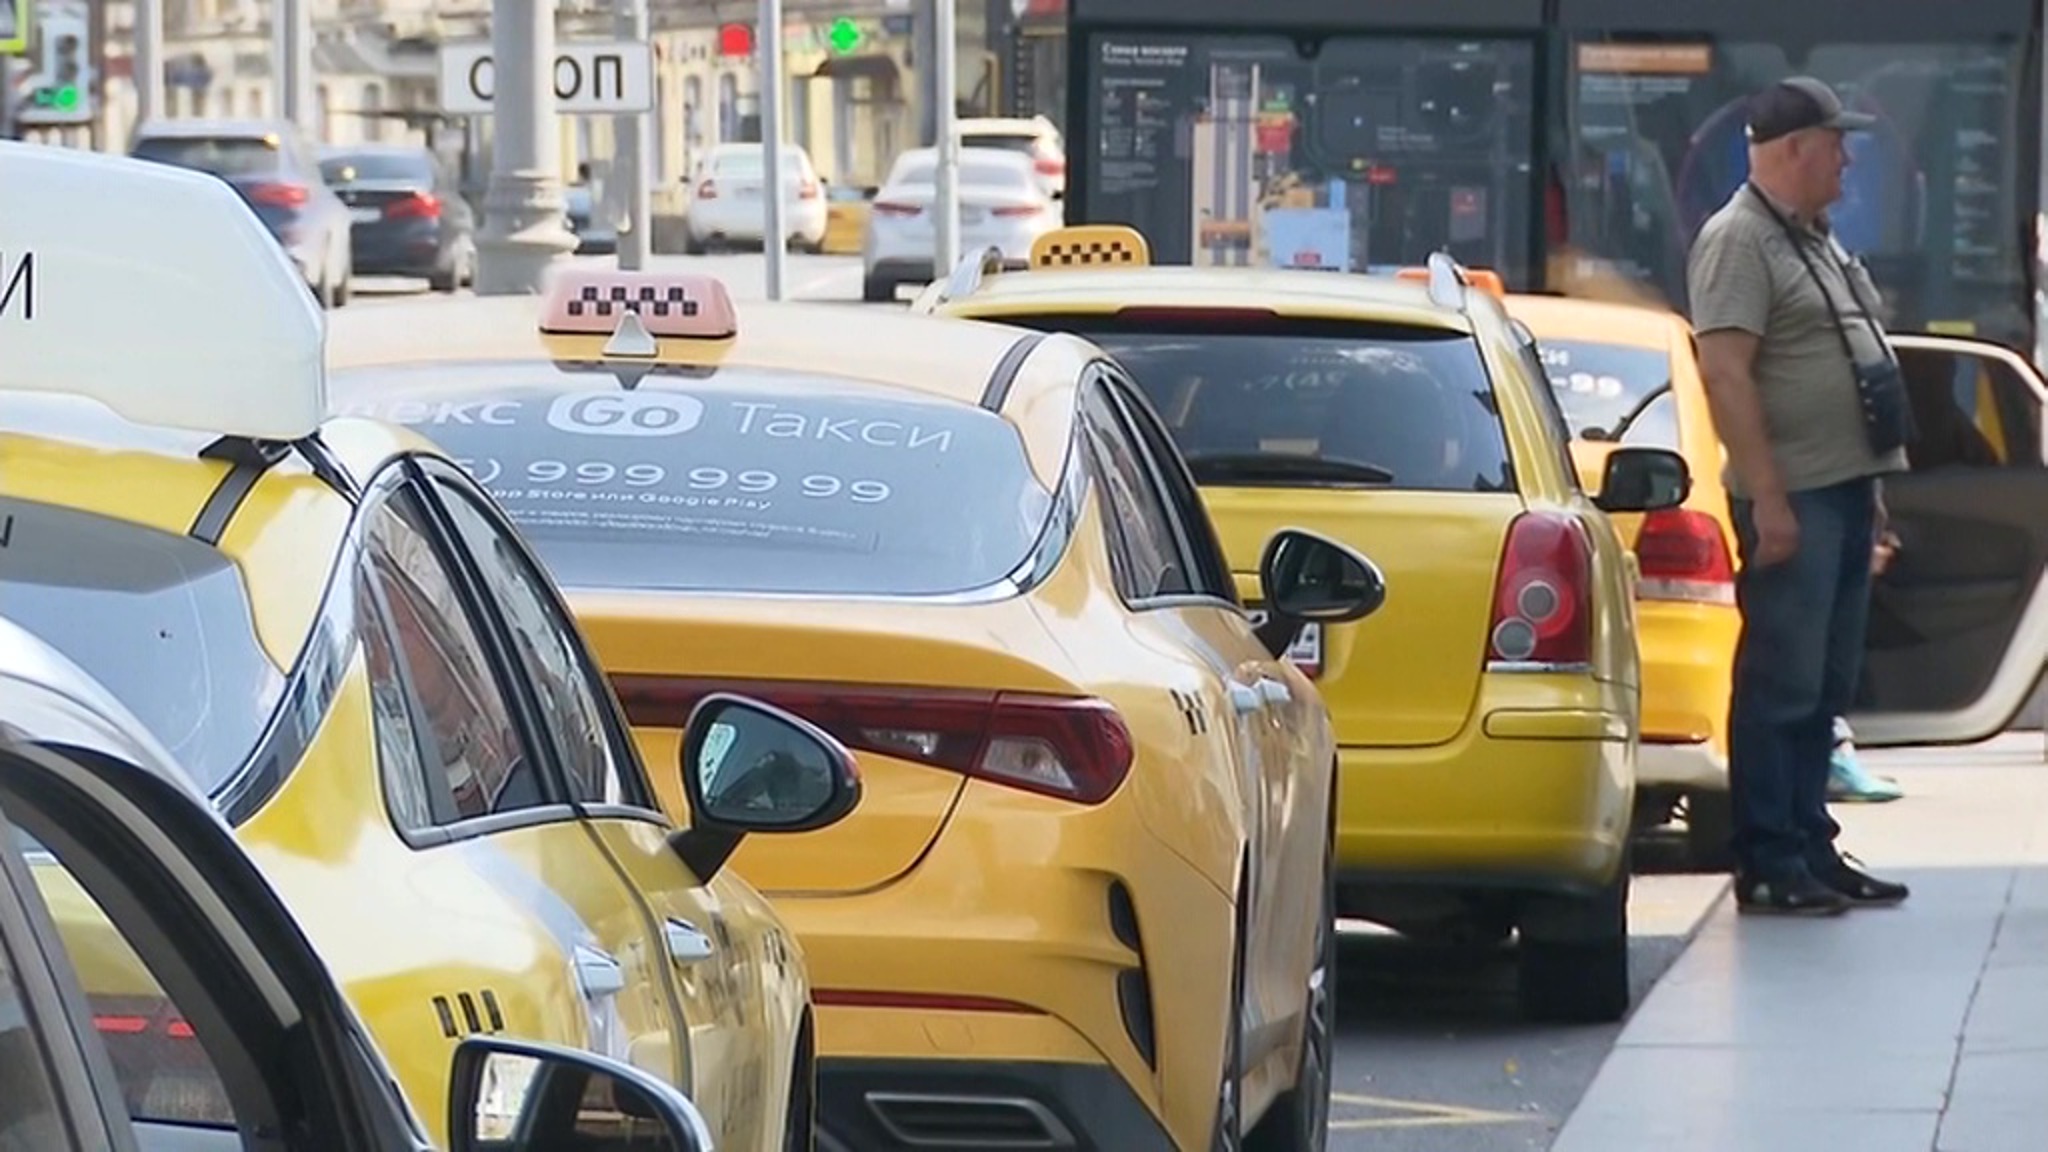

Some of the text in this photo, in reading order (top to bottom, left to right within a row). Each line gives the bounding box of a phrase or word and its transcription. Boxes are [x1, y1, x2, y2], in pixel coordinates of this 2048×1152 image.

[469, 54, 623, 101] СОП
[566, 393, 687, 430] Go
[731, 401, 953, 453] Такси
[527, 460, 666, 486] 999
[688, 466, 779, 493] 99
[801, 474, 891, 503] 99
[527, 489, 588, 500] Store
[638, 491, 718, 508] Google
[723, 497, 772, 511] Play
